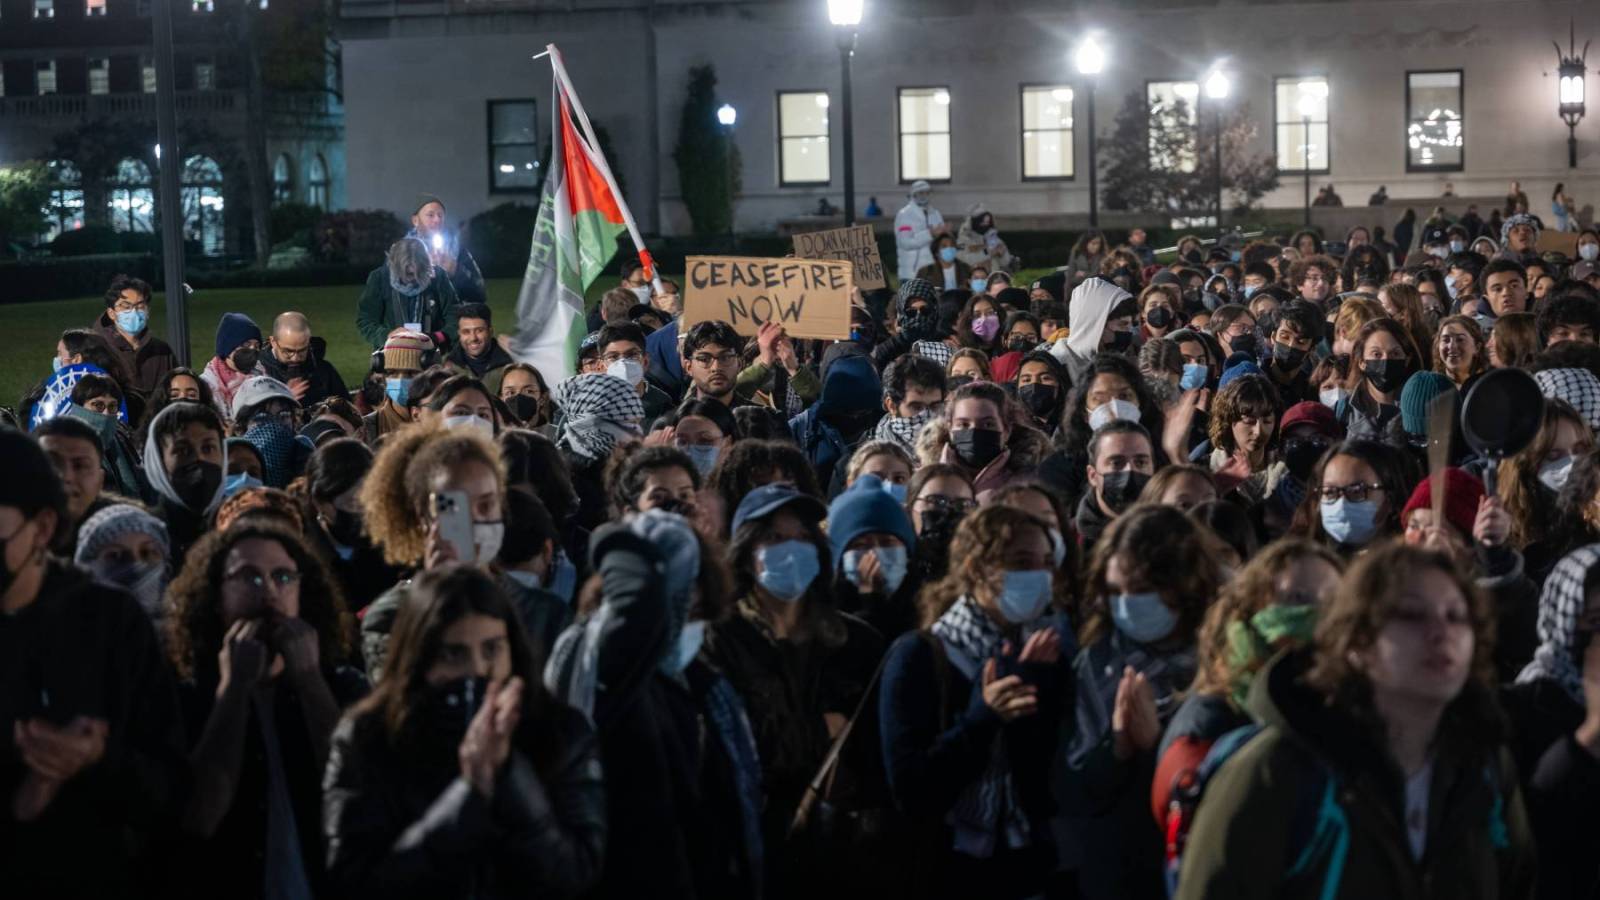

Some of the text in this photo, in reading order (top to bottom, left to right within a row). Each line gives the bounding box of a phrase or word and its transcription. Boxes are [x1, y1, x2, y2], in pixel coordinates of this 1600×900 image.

[801, 225, 872, 255] DOWN WITH
[692, 261, 847, 290] CEASEFIRE
[727, 294, 805, 326] NOW
